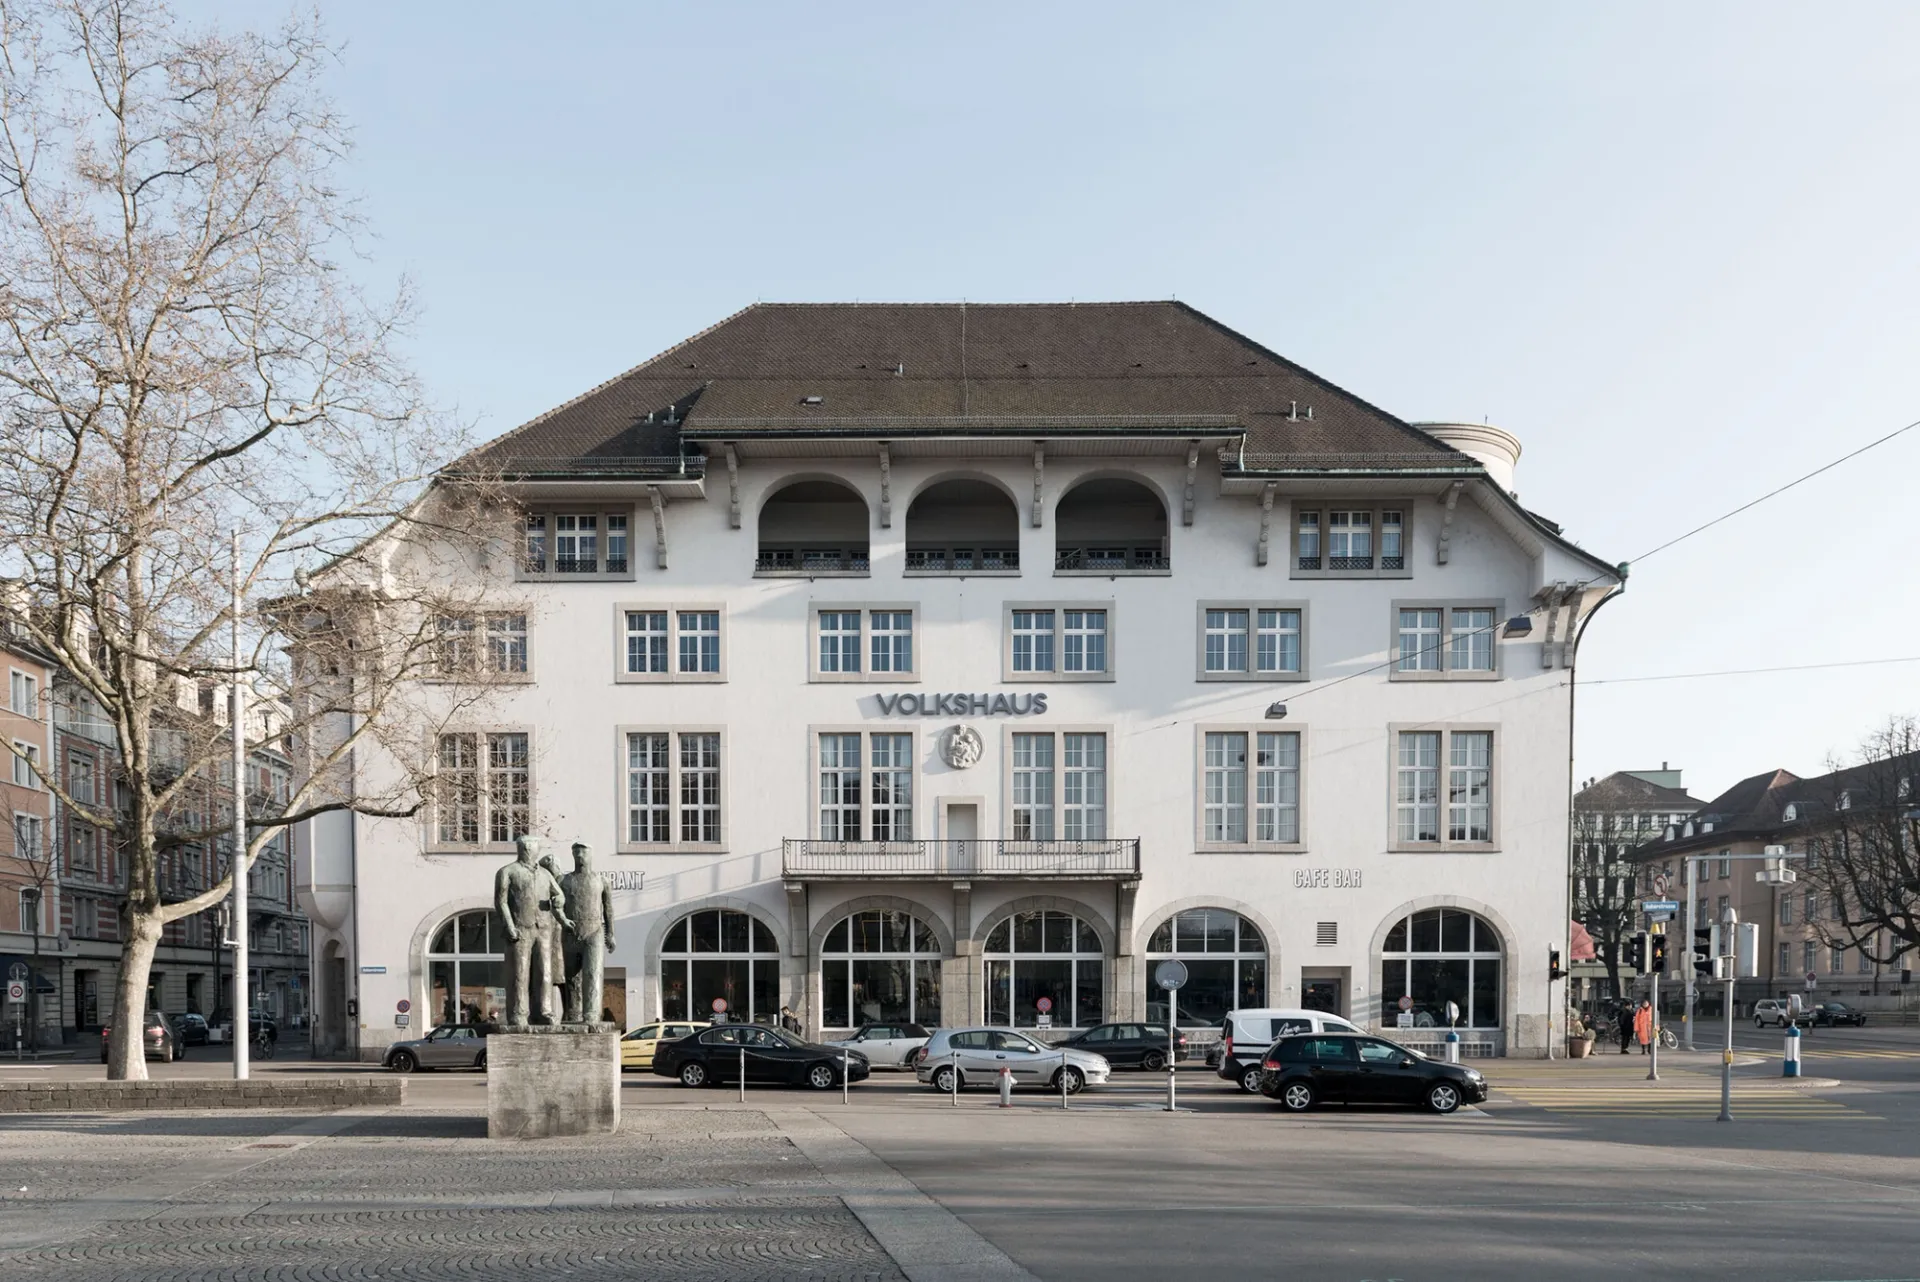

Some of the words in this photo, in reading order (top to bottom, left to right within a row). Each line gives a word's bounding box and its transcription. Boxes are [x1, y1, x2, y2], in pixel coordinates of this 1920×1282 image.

[876, 692, 1048, 716] VOLKSHAUS
[598, 870, 645, 890] RANT
[1293, 868, 1329, 888] CAFE
[1334, 868, 1362, 888] BAR
